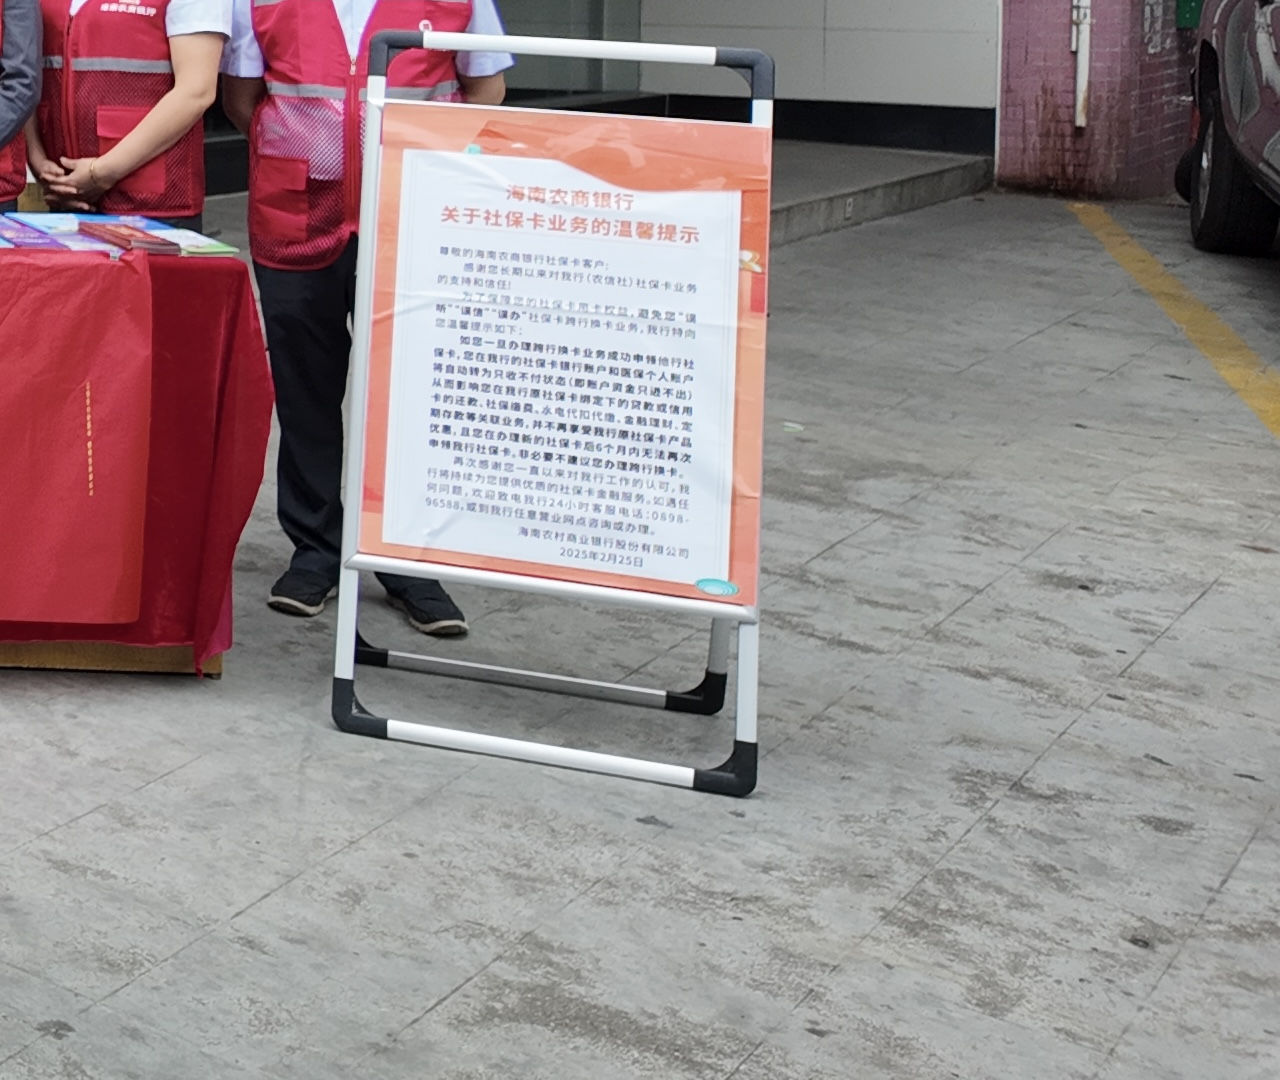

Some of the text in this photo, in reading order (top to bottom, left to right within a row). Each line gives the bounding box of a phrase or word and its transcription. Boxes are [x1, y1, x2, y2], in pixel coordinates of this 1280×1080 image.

[505, 184, 635, 211] 海南农商银行
[440, 205, 701, 245] 关于社保卡业务的温馨提示
[518, 526, 690, 560] 海南农村商业银行股份有限公司
[559, 546, 644, 568] 2025年2月25日
